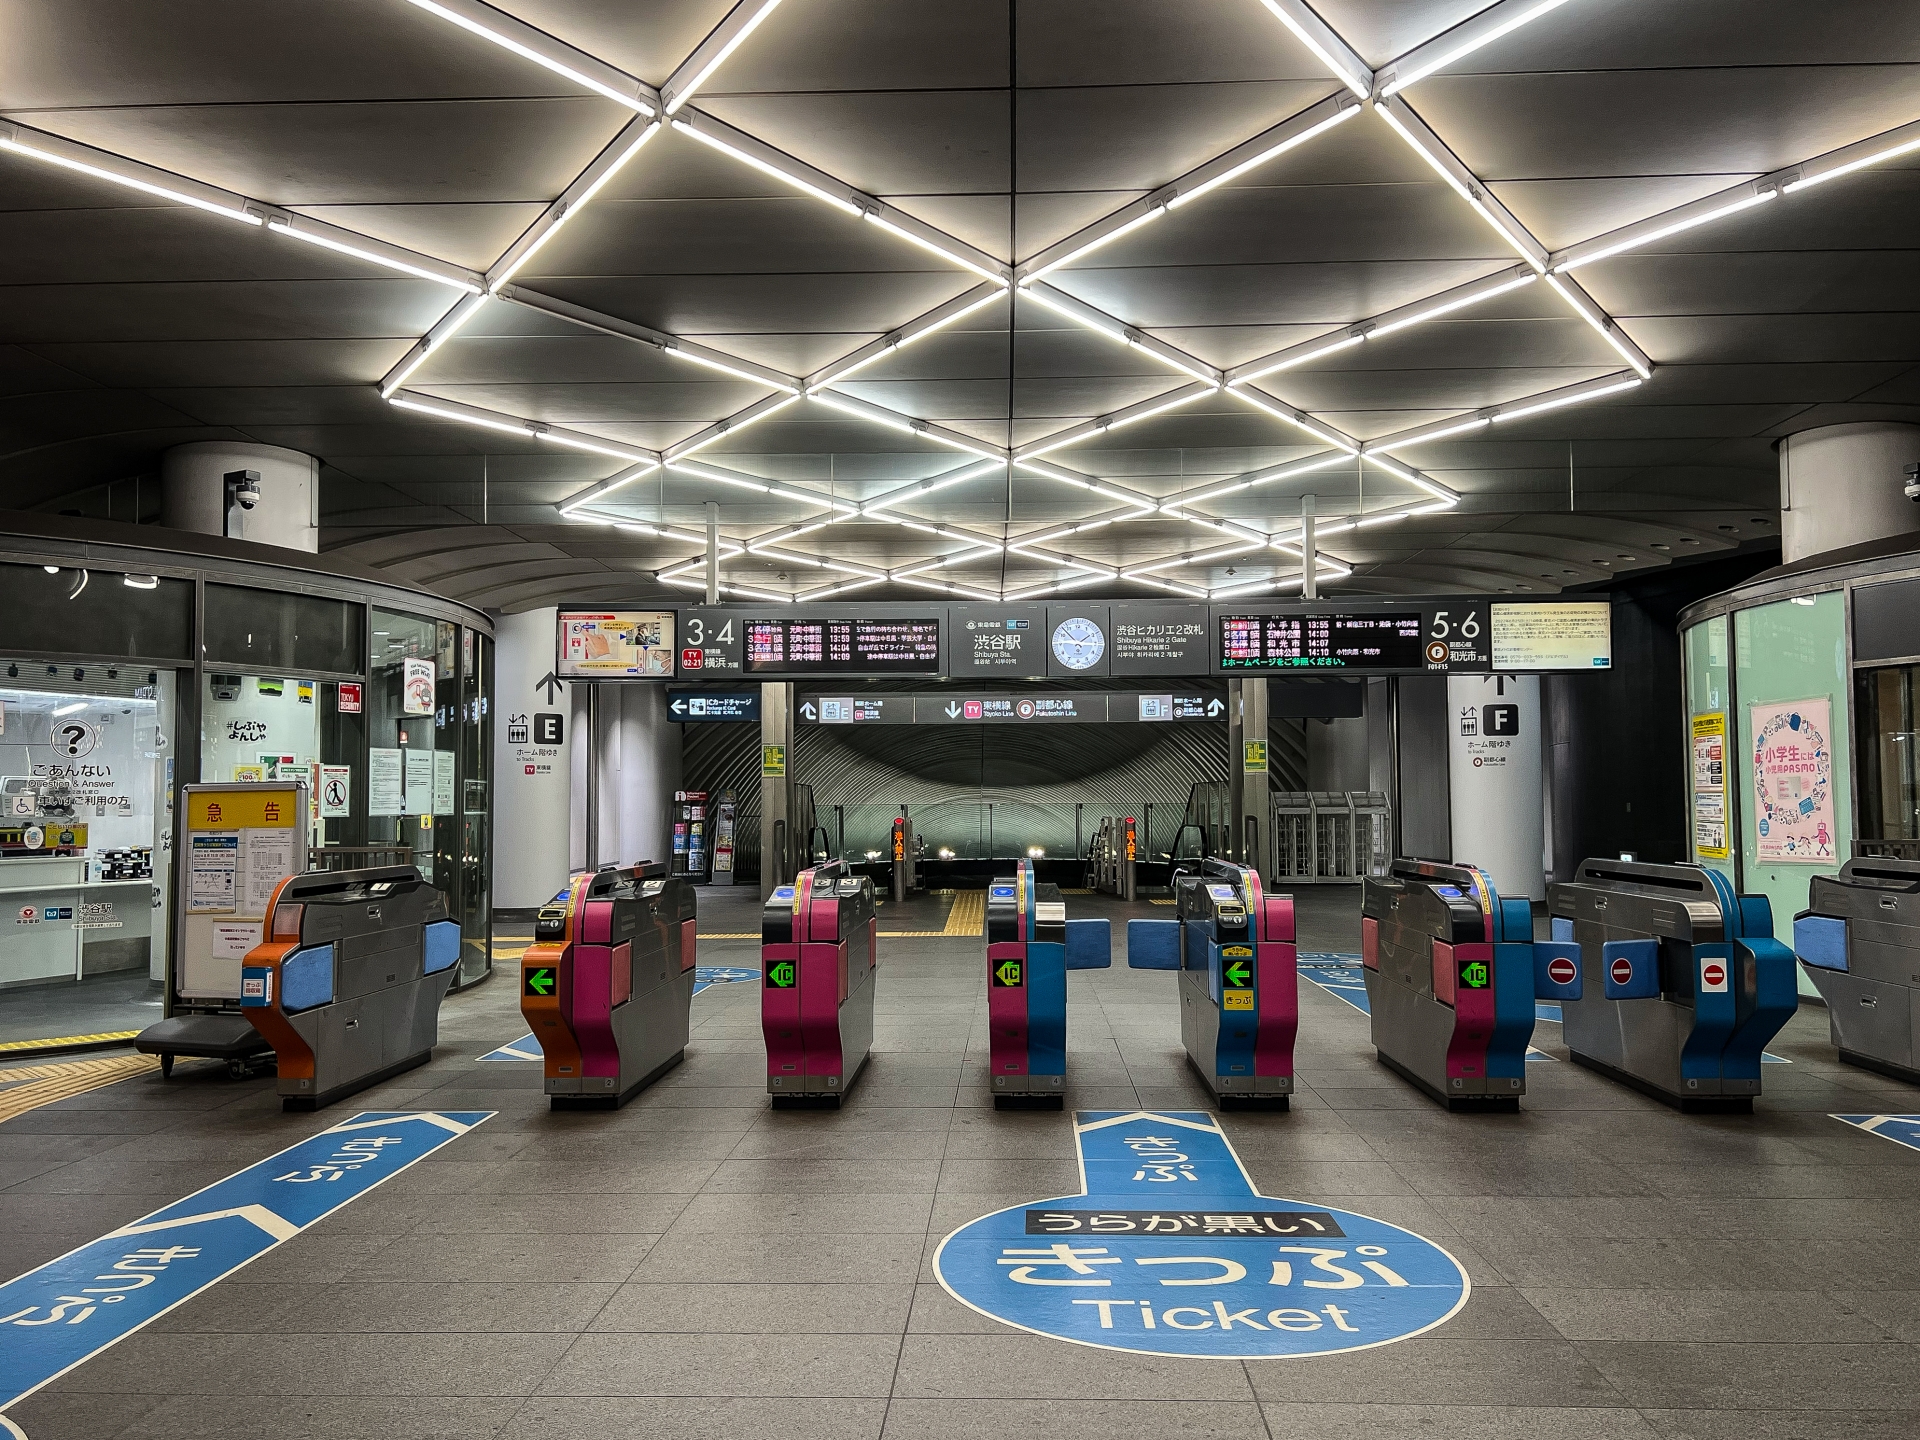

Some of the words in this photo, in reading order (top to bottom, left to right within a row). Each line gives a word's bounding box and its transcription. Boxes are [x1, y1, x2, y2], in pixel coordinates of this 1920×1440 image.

[1116, 624, 1203, 635] 渋谷ヒカリエ2改札
[974, 634, 1021, 650] 渋谷駅
[1450, 651, 1476, 662] 和光市
[705, 658, 726, 668] 横浜
[983, 701, 1011, 710] 東横線
[1036, 700, 1073, 709] 副都心線
[1161, 705, 1168, 716] F
[841, 708, 848, 719] E
[226, 720, 266, 732] #しぶや
[1495, 710, 1507, 730] F
[545, 720, 555, 739] E
[1765, 745, 1814, 763] 小学生には
[34, 764, 111, 777] ごあんない
[1766, 764, 1815, 774] 小児用PASMO
[38, 796, 129, 806] 車いすご利用の方
[778, 969, 790, 980] IC
[1004, 968, 1017, 979] IC
[1470, 969, 1484, 981] IC
[1226, 996, 1252, 1004] きっぷ
[273, 1136, 402, 1184] きっぷ
[1124, 1136, 1199, 1182] きっぷ
[1038, 1213, 1326, 1234] うらが黒い
[997, 1244, 1410, 1290] きっぷ
[0, 1245, 202, 1327] きっぷ
[1072, 1300, 1360, 1332] Ticket
